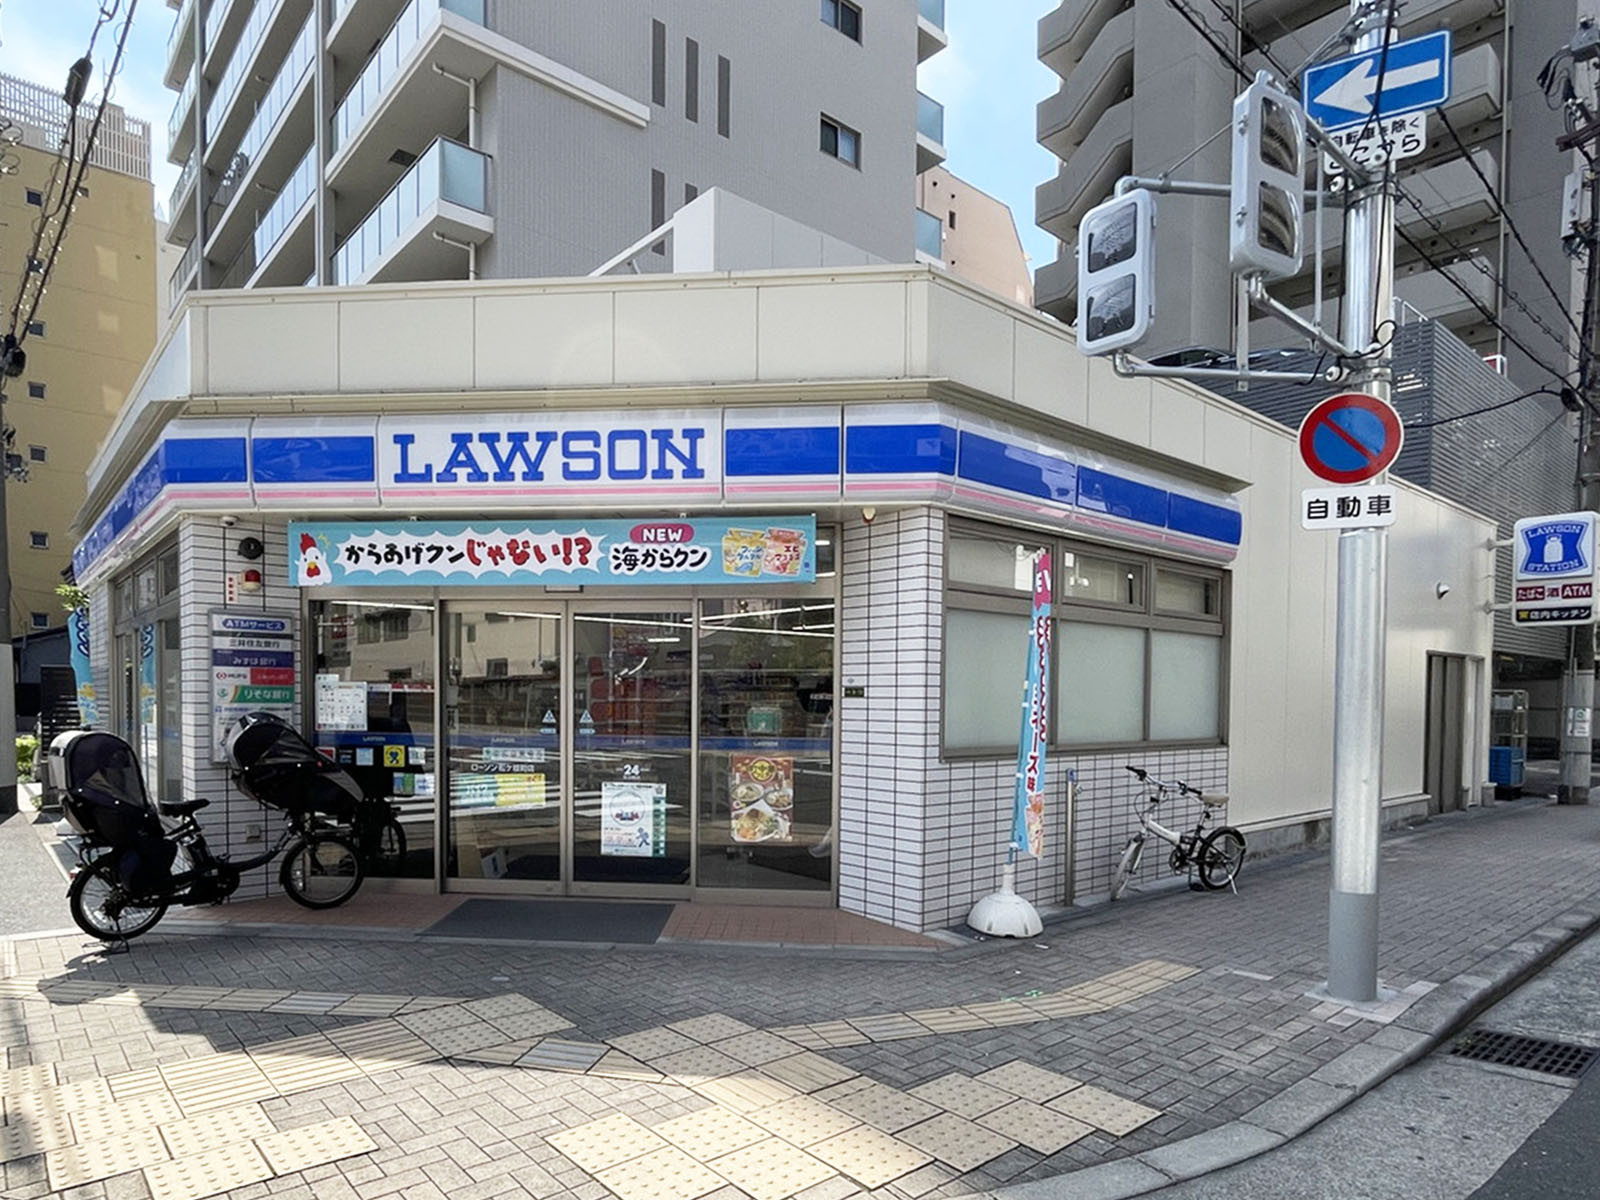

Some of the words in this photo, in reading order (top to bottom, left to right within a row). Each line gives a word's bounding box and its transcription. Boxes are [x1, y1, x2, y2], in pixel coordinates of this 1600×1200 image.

[393, 428, 705, 483] LAWSON
[1307, 494, 1392, 519] 自動車
[642, 528, 684, 542] NEW
[1527, 525, 1581, 538] LAWSON
[612, 546, 707, 572] 海からクン
[1527, 559, 1579, 572] STATION
[1517, 588, 1544, 600] たばこ
[1563, 584, 1591, 597] ATM
[225, 620, 282, 630] ATMサービス
[623, 764, 640, 776] 24
